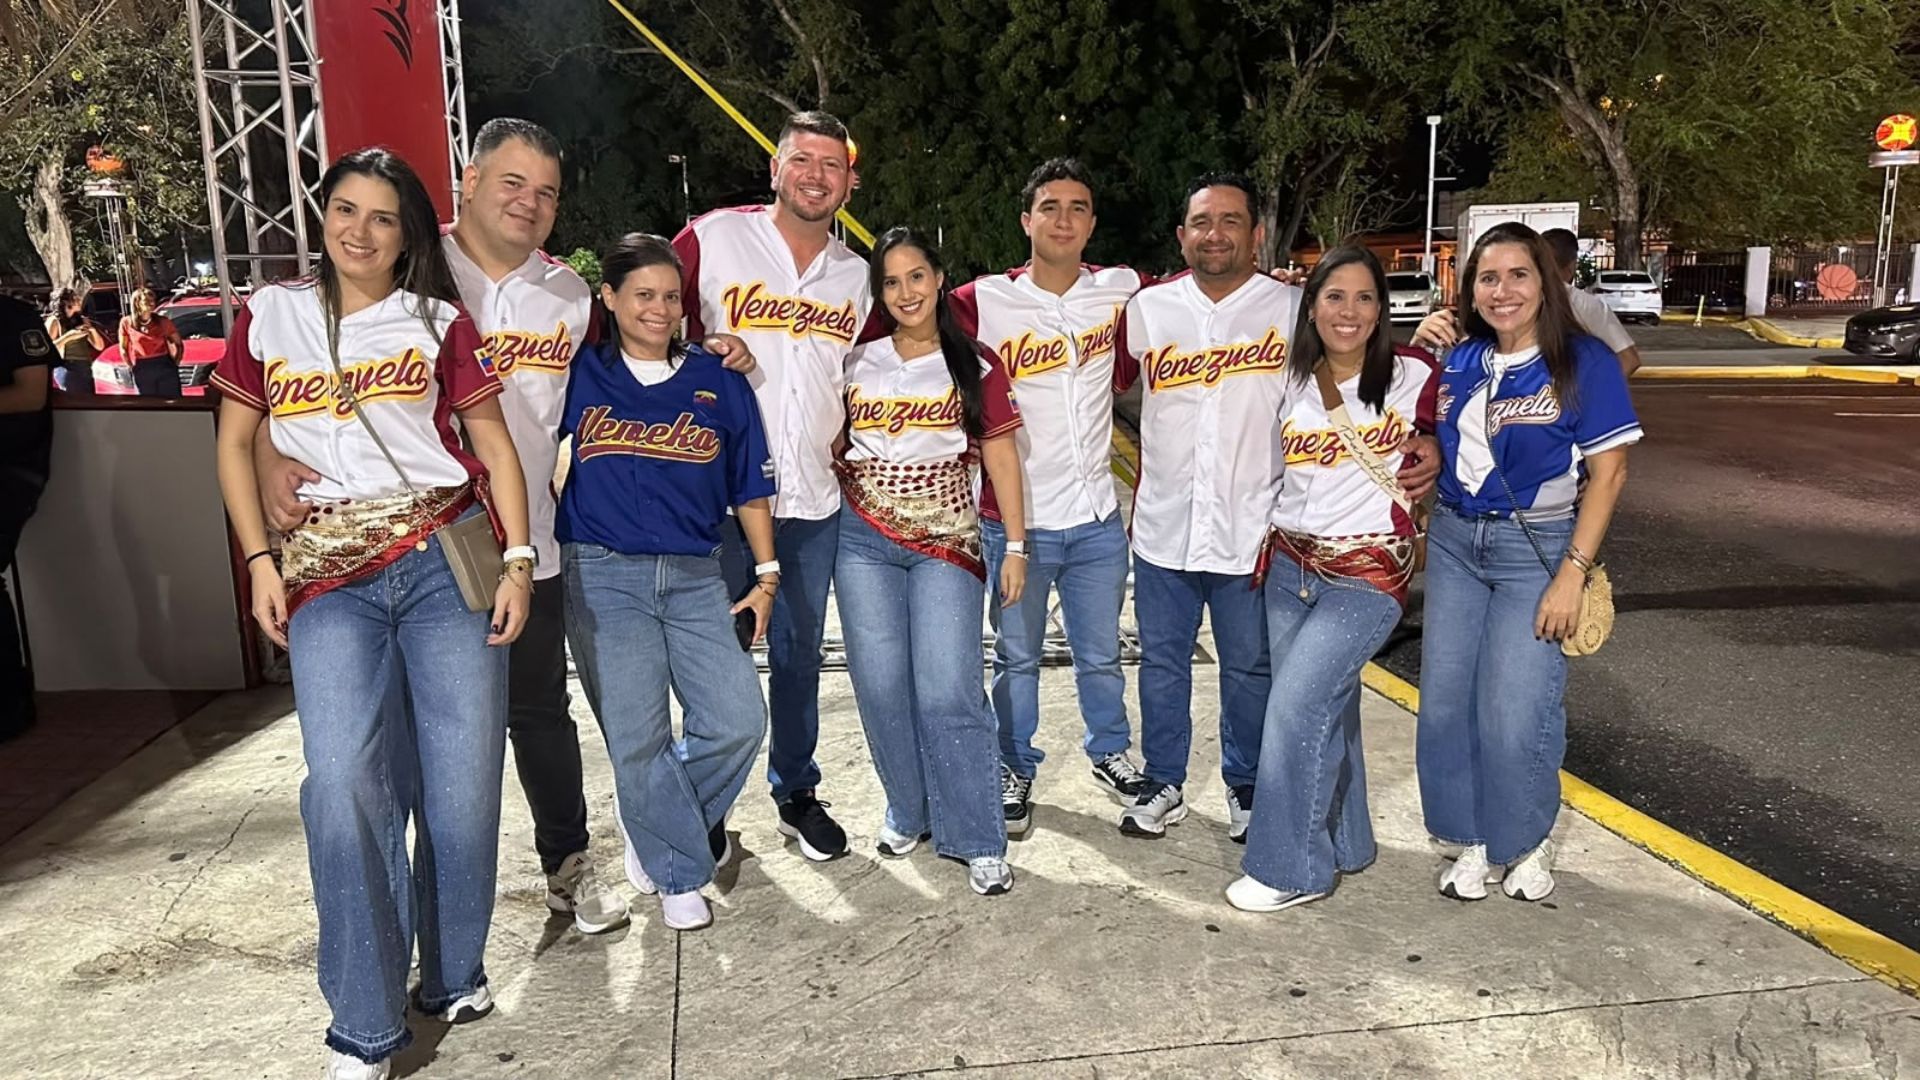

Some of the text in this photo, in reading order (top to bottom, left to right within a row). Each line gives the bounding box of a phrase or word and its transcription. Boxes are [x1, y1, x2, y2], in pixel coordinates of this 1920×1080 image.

[724, 283, 856, 342] Venezuela
[483, 326, 571, 373] ezuela
[1000, 307, 1118, 378] Venezuel
[1145, 330, 1285, 388] Venezuela
[577, 405, 721, 465] Veneka
[1281, 411, 1403, 465] enezela
